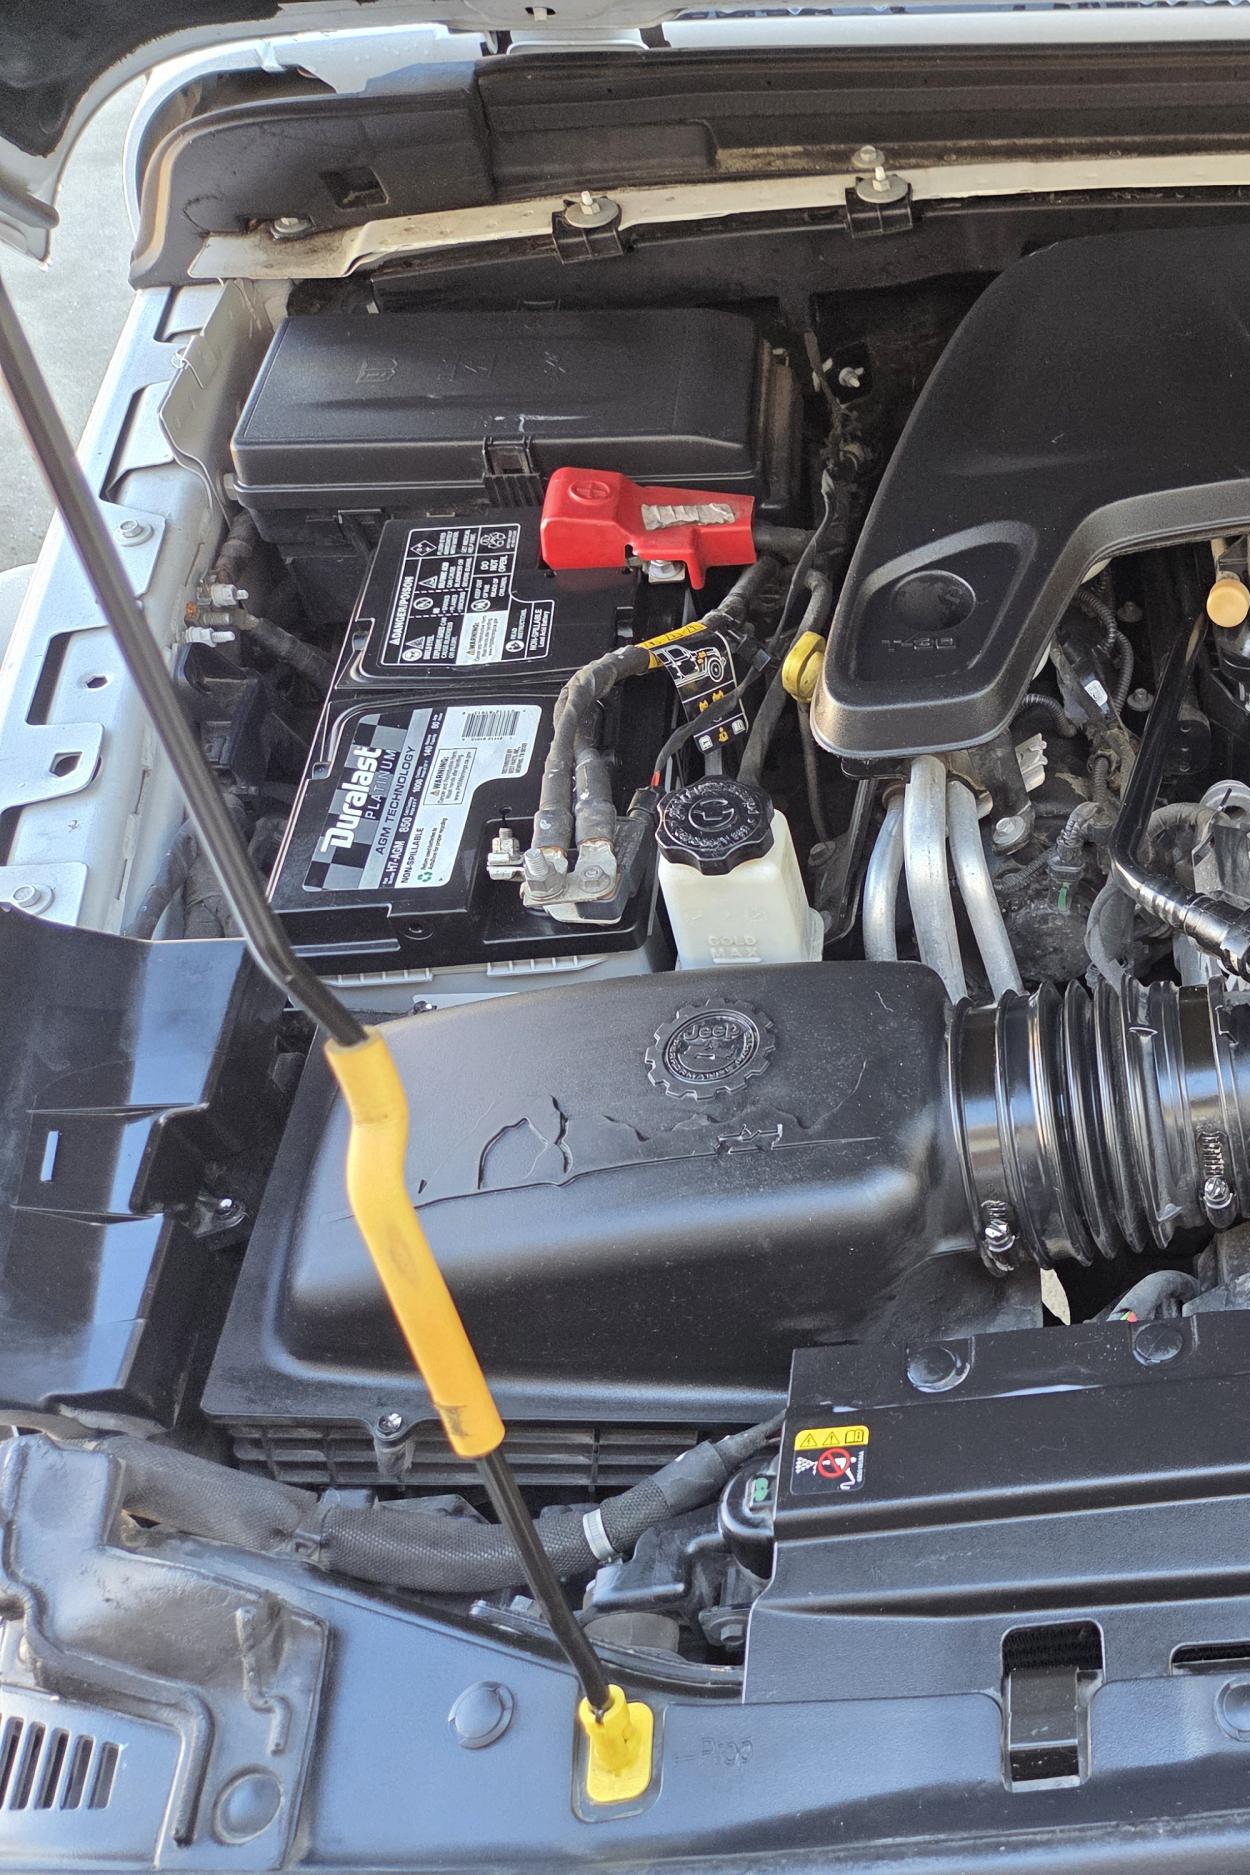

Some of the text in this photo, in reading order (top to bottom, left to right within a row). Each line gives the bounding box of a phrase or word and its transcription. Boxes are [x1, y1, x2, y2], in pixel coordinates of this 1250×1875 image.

[480, 561, 489, 570] DO
[489, 559, 498, 571] NOT
[393, 576, 414, 638] DANGER/POISON
[424, 745, 434, 757] 140
[365, 749, 397, 820] PLATINUM
[434, 756, 449, 789] WARNING:
[320, 744, 382, 853] Duralast
[375, 825, 392, 855] AGM
[386, 746, 416, 824] TECHNOLOGY
[386, 840, 406, 873] H7-AGM
[399, 816, 411, 833] 850
[400, 827, 424, 884] NON-SPILLABLE
[708, 935, 758, 946] COLD
[710, 947, 762, 958] MAX
[683, 1023, 741, 1041] Jeep
